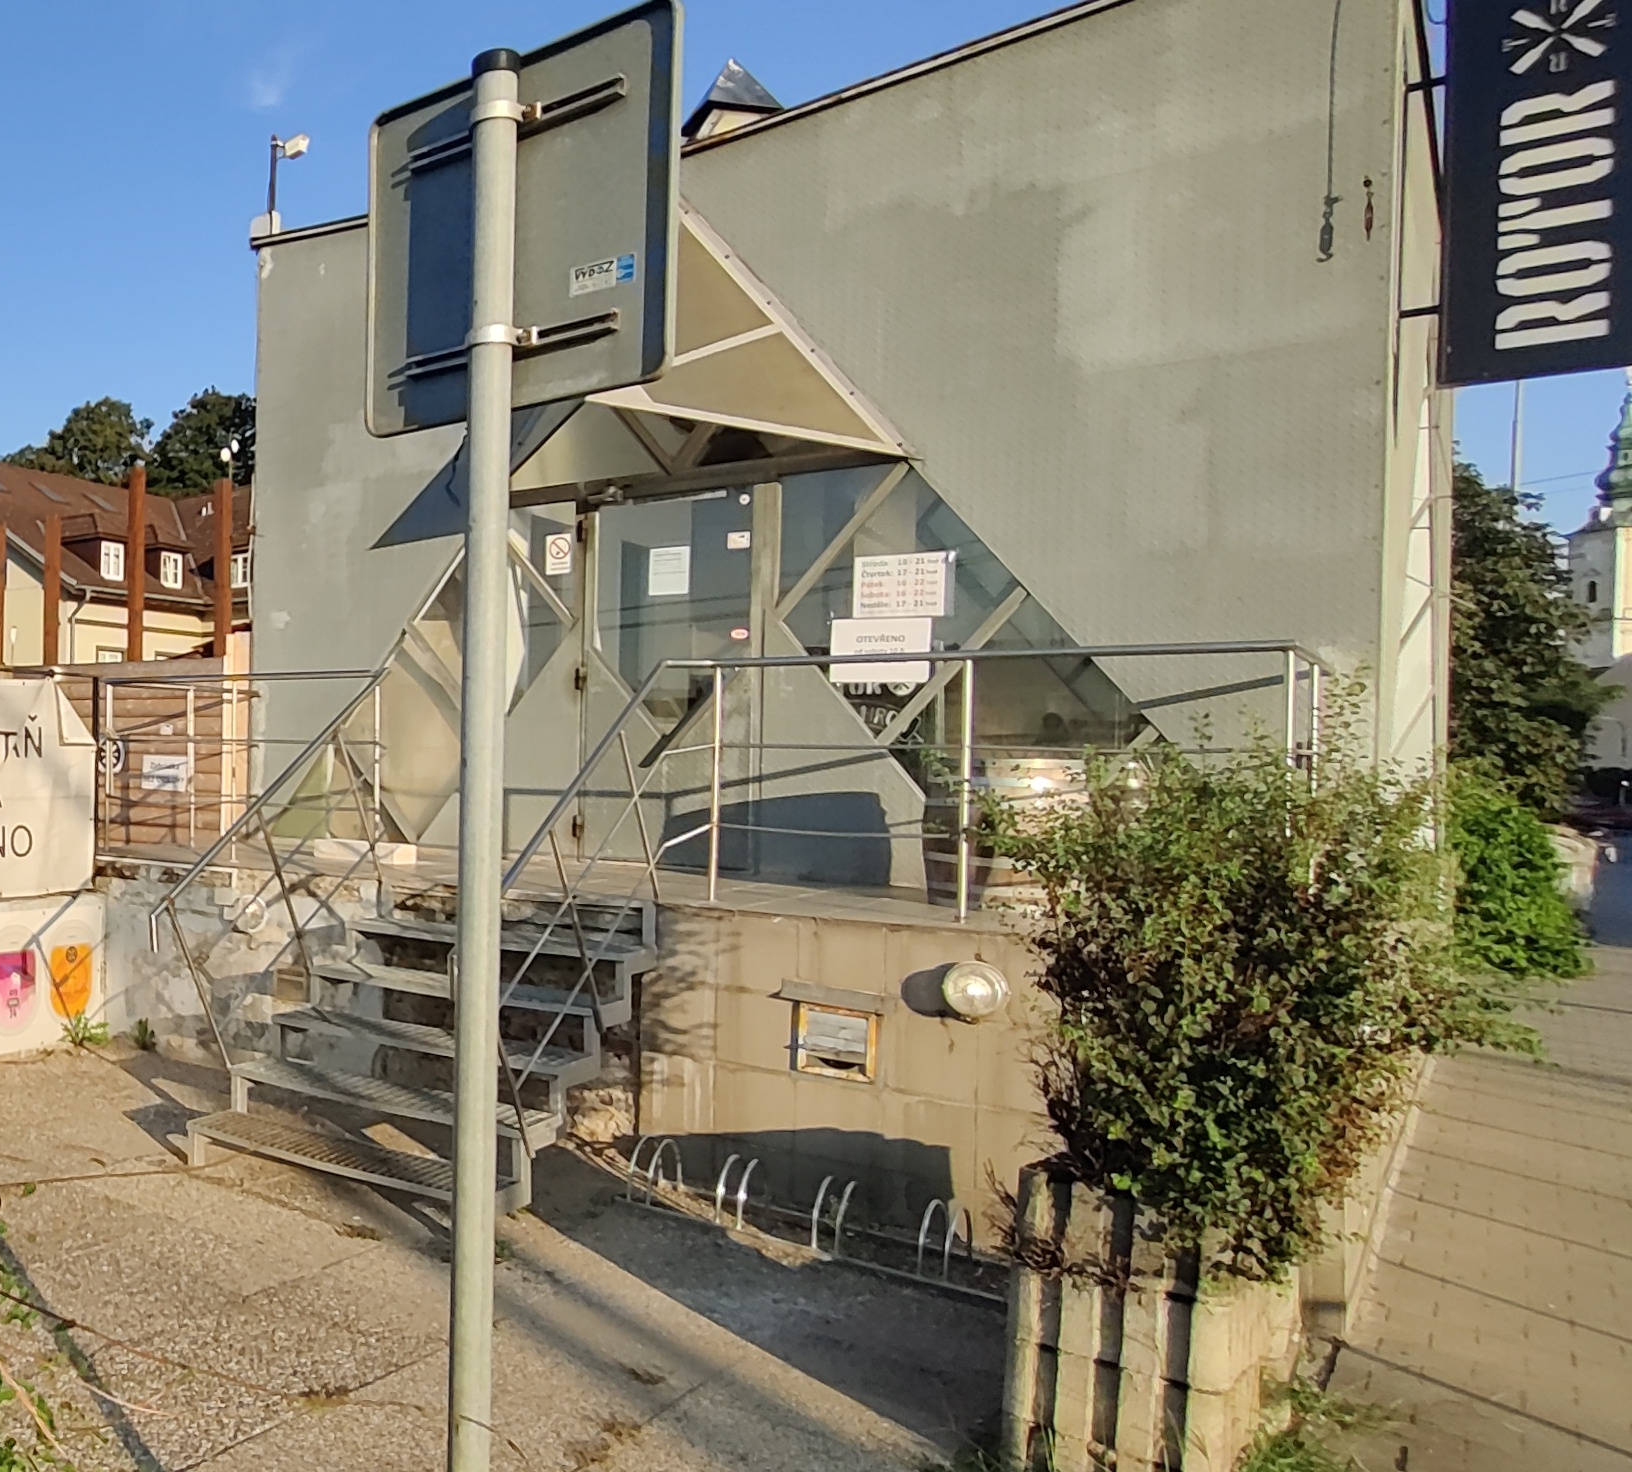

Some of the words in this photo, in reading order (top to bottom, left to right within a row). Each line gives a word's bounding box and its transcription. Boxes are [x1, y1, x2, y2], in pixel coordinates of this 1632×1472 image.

[1494, 79, 1616, 350] ROTOR
[915, 557, 925, 565] 21
[896, 579, 907, 587] 16
[896, 590, 906, 598] 16
[913, 589, 925, 597] 22
[896, 600, 906, 608] 17
[855, 634, 906, 643] OTEVŘENO
